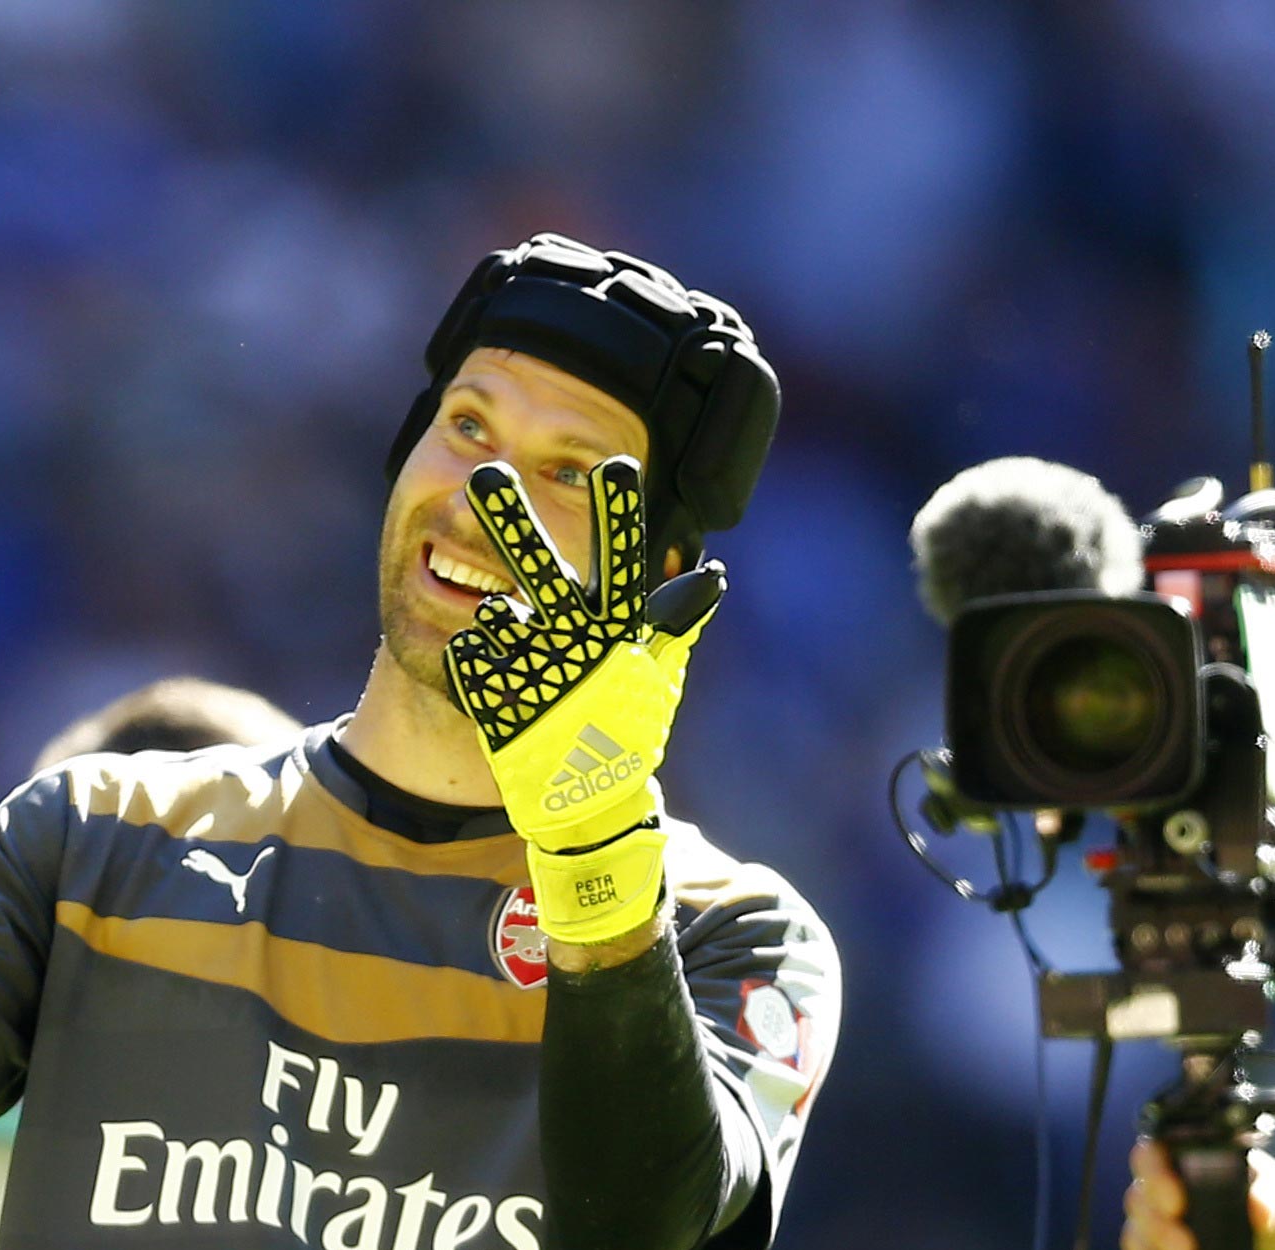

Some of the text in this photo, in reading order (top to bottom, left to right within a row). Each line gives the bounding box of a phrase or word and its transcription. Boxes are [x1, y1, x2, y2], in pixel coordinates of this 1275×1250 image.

[544, 751, 643, 812] adidas
[575, 873, 614, 894] PETR
[578, 886, 618, 908] CECH
[262, 1040, 399, 1157] Fly
